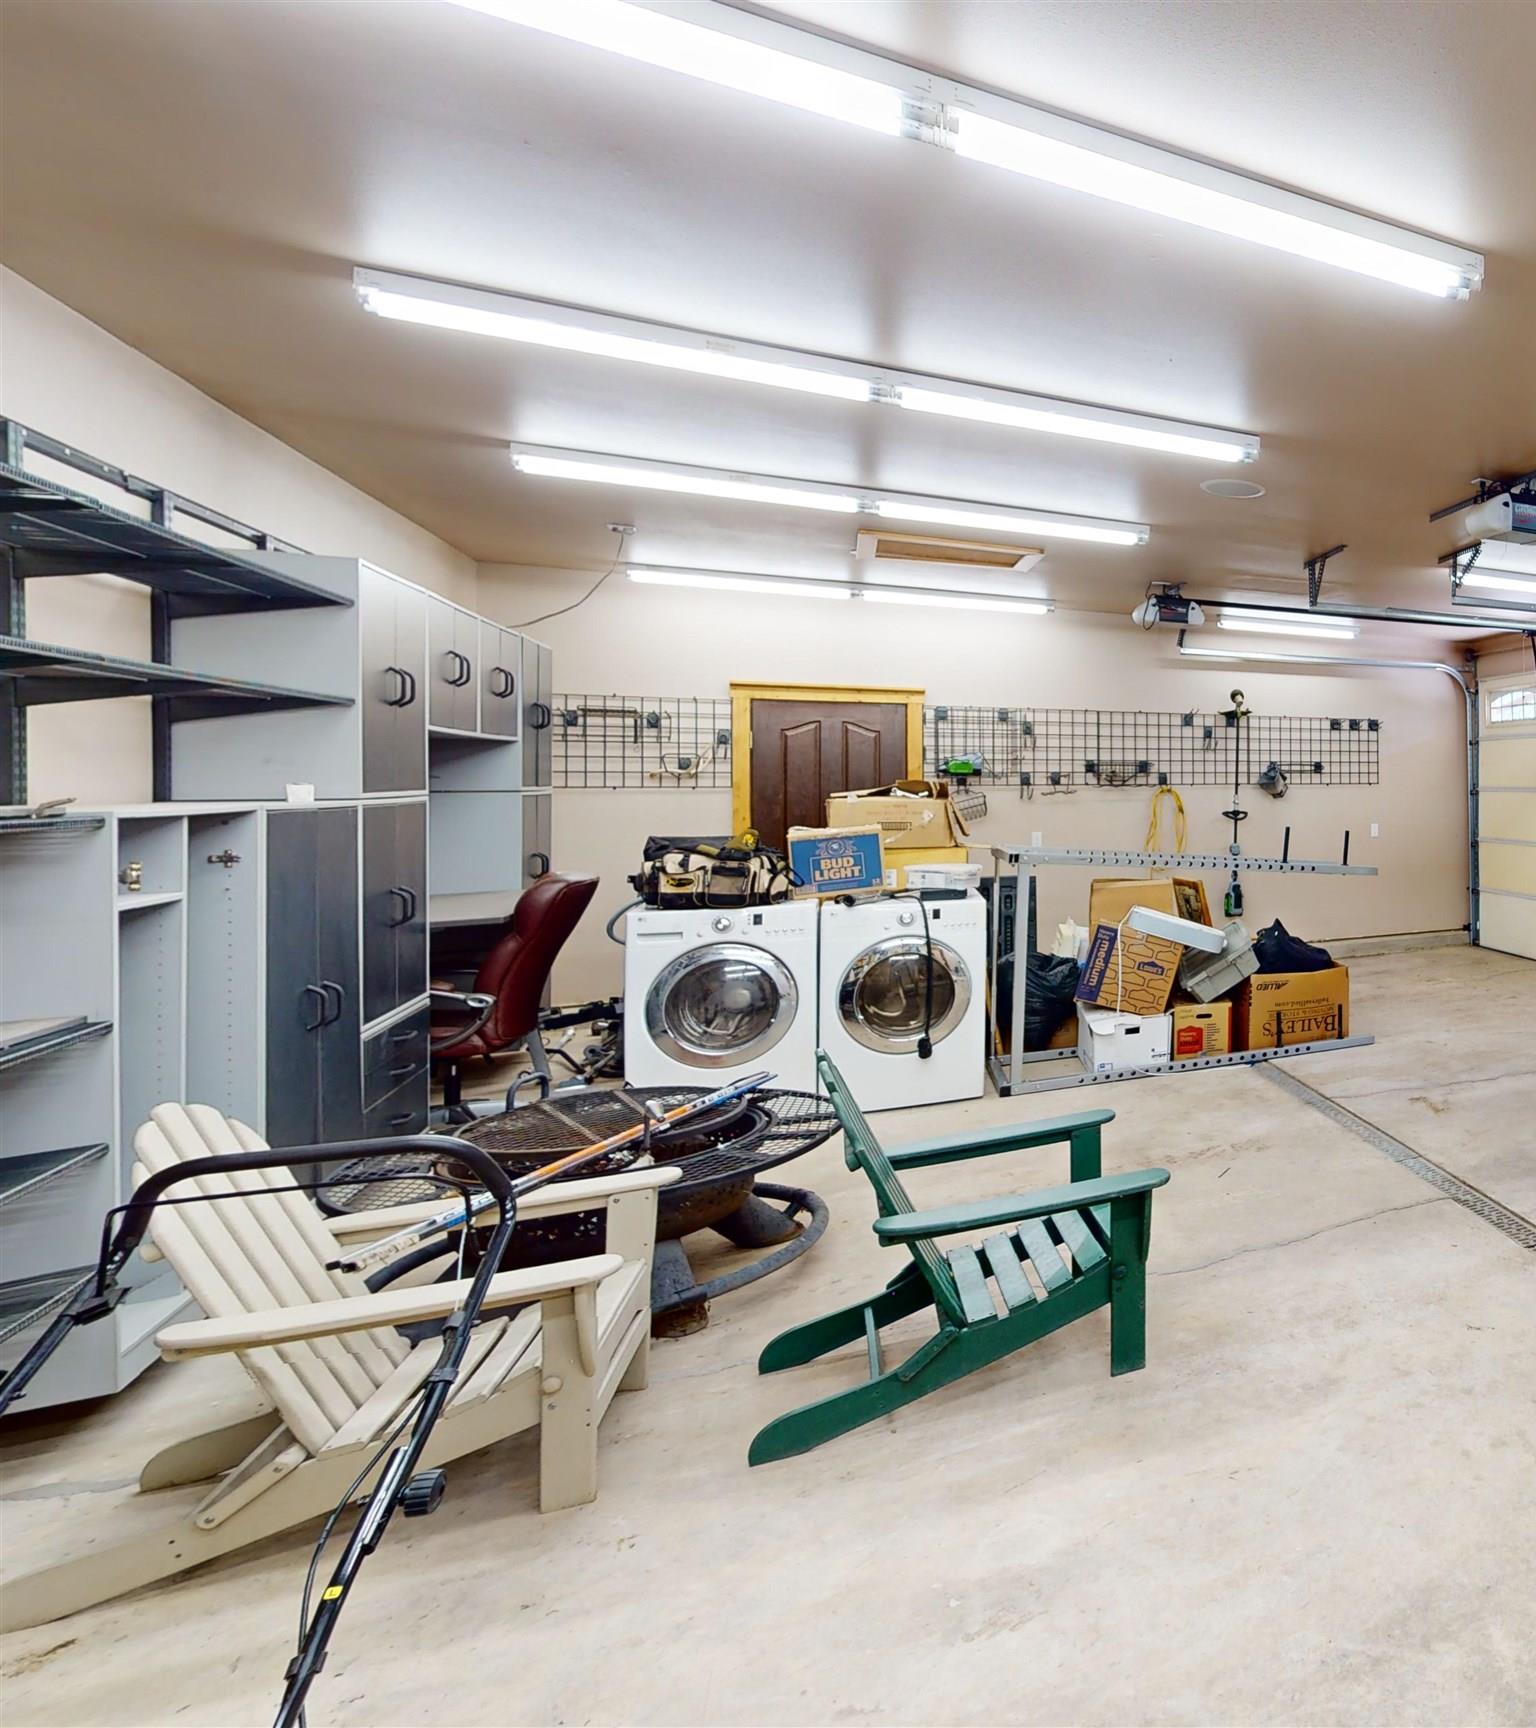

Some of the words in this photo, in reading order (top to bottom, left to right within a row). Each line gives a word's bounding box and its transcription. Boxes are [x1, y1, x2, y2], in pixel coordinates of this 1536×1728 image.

[820, 855, 855, 870] BUD
[814, 865, 862, 881] LIGHT
[1088, 940, 1110, 986] medium
[1256, 982, 1289, 991] ALLIED
